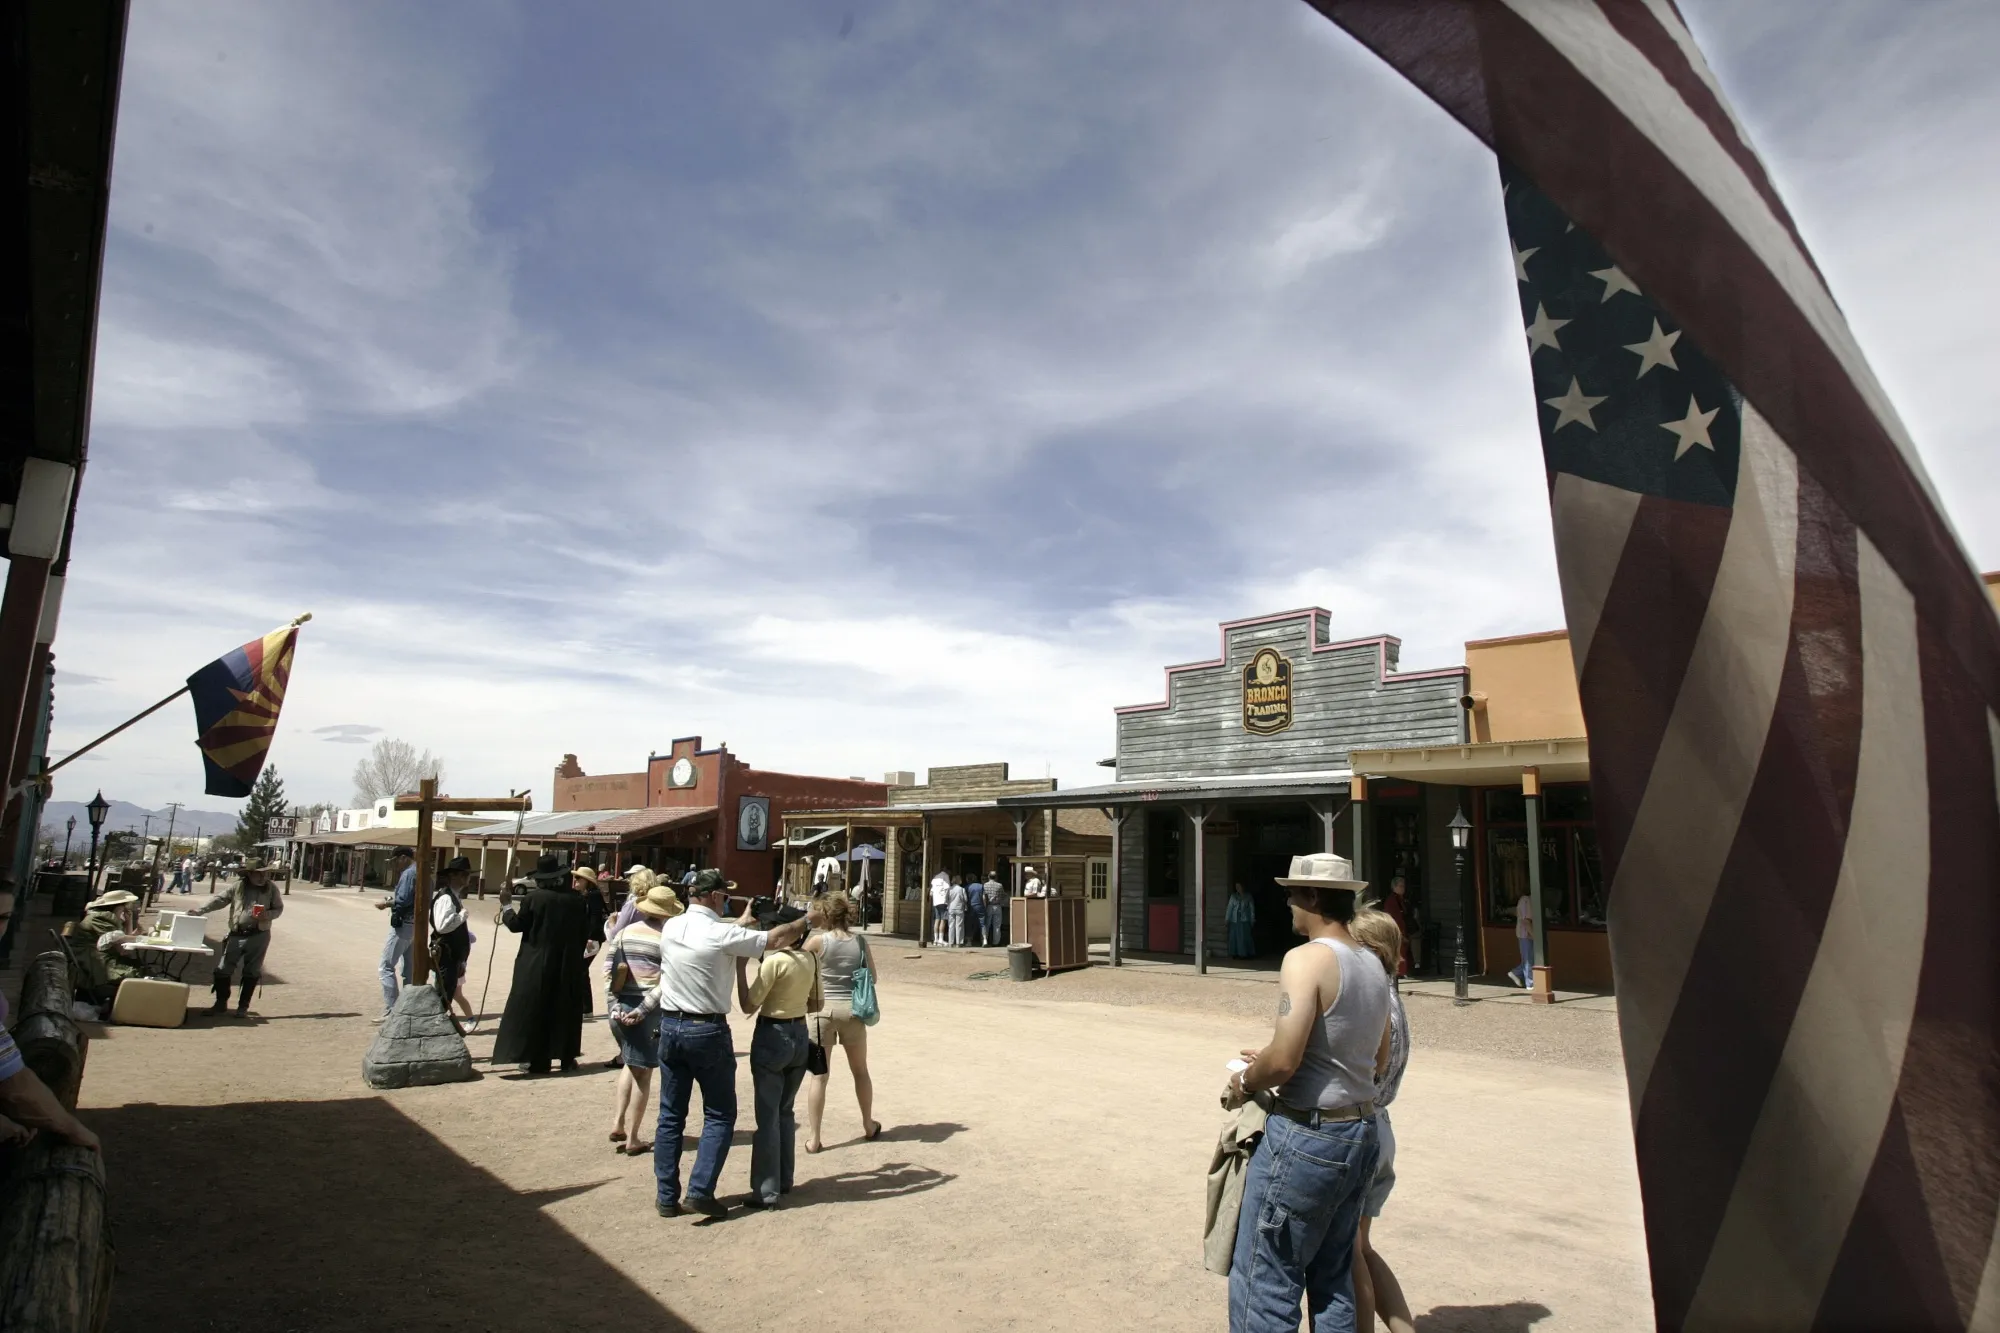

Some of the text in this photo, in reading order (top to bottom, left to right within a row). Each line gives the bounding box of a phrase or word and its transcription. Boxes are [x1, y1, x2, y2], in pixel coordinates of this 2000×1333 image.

[1247, 685, 1287, 703] BRONCO
[1247, 703, 1287, 716] TRADING
[271, 818, 292, 828] O.K.
